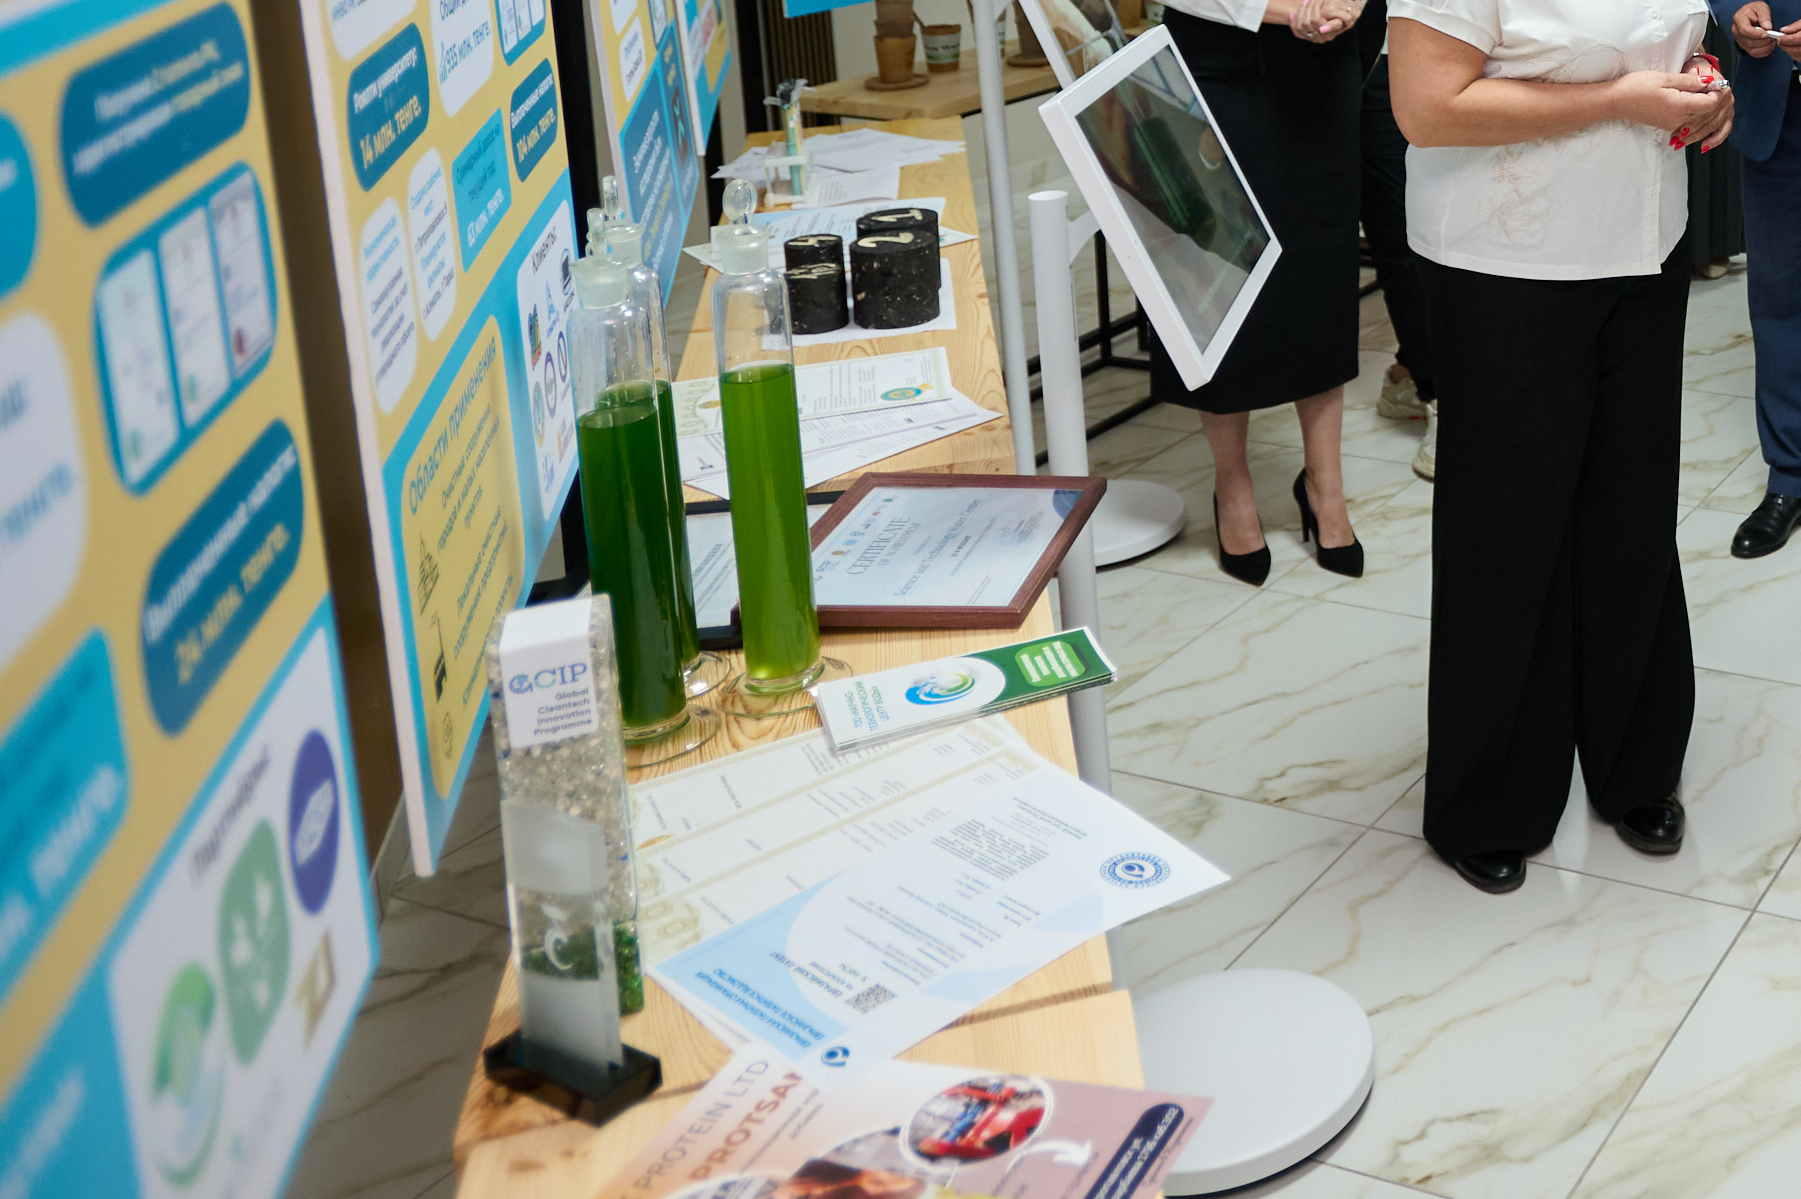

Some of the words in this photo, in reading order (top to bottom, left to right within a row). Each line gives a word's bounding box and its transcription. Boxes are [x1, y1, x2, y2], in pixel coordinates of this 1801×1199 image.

[445, 44, 457, 74] 935
[458, 33, 472, 62] млн.
[472, 17, 490, 49] тенге.
[377, 44, 416, 97] университету:
[511, 87, 538, 129] Выплаченные
[360, 133, 373, 171] 14
[373, 115, 395, 157] млн.
[395, 91, 421, 137] тенге.
[517, 134, 527, 163] 104
[527, 122, 539, 151] млн.
[539, 104, 555, 136] тенге.
[467, 220, 475, 248] 63
[475, 206, 487, 238] млн.
[487, 185, 503, 220] тенге.
[531, 227, 557, 275] Клиенты:
[409, 421, 447, 516] Области
[449, 336, 495, 442] применения
[947, 516, 968, 530] Water
[959, 499, 982, 515] Center
[240, 523, 290, 595] тенге.
[844, 517, 912, 574] CERTIFICATE
[921, 533, 958, 562] Technology
[892, 575, 921, 596] Science
[912, 563, 931, 574] and
[537, 698, 590, 714] Cleantech
[555, 687, 589, 701] Global
[534, 719, 592, 735] Programme
[537, 708, 591, 725] Innovation
[767, 950, 797, 968] ПАТЕНТ
[791, 965, 844, 998] ЕВРАЗИЙСКИЙ
[633, 1101, 731, 1190] PROTEIN
[724, 1061, 769, 1097] LTD
